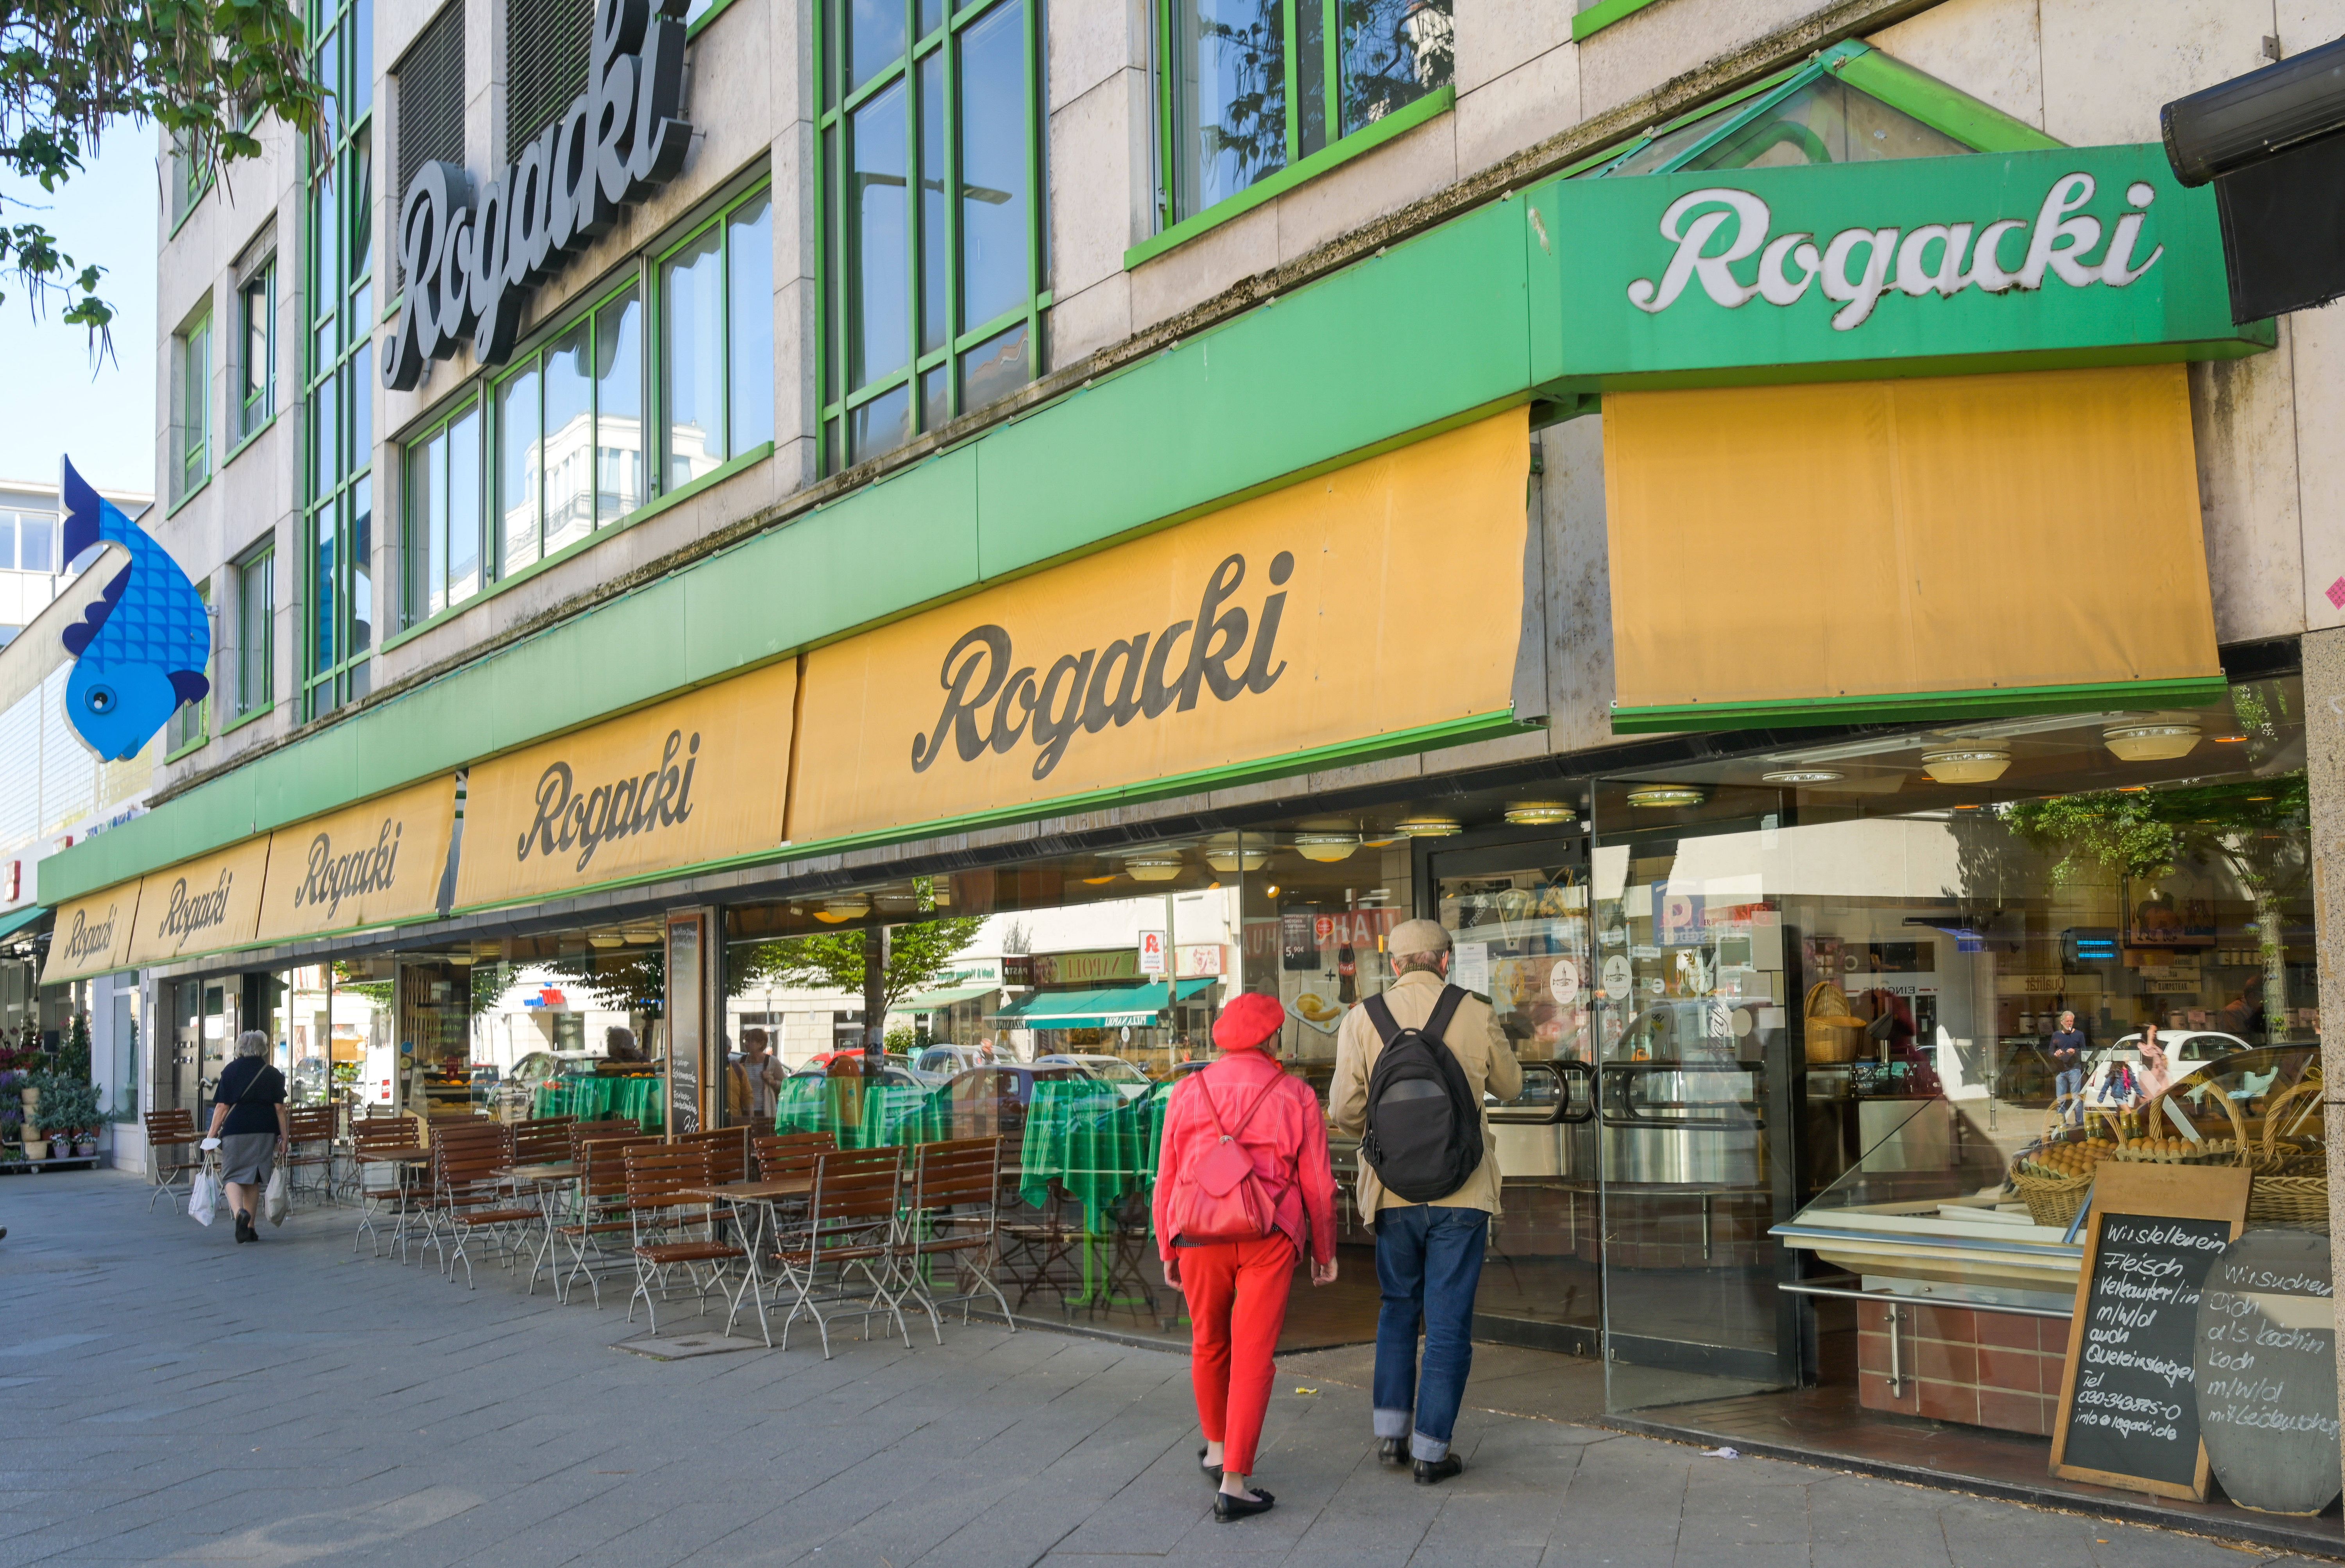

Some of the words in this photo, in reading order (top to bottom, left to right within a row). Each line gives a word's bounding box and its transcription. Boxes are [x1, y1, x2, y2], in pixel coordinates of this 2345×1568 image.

[381, 0, 694, 391] Rogacki
[1627, 172, 2163, 331] Rogacki
[912, 551, 1294, 780] Rogacki
[518, 729, 700, 870] Rogacki
[295, 818, 404, 920] Rogacki
[159, 867, 233, 948] Rogacki
[64, 904, 118, 968] Rogacki
[1285, 945, 1305, 959] 5,90€
[2158, 983, 2188, 991] RUMPSTEAK
[2107, 1224, 2134, 1242] Wir
[2135, 1225, 2198, 1247] stellen
[2195, 1232, 2227, 1254] ein
[2104, 1252, 2183, 1277] Fleisch
[2225, 1264, 2256, 1284] Wir
[2210, 1291, 2260, 1318] Dich
[2089, 1327, 2130, 1344] auch
[2207, 1319, 2249, 1342] als
[2083, 1369, 2105, 1387] Tel
